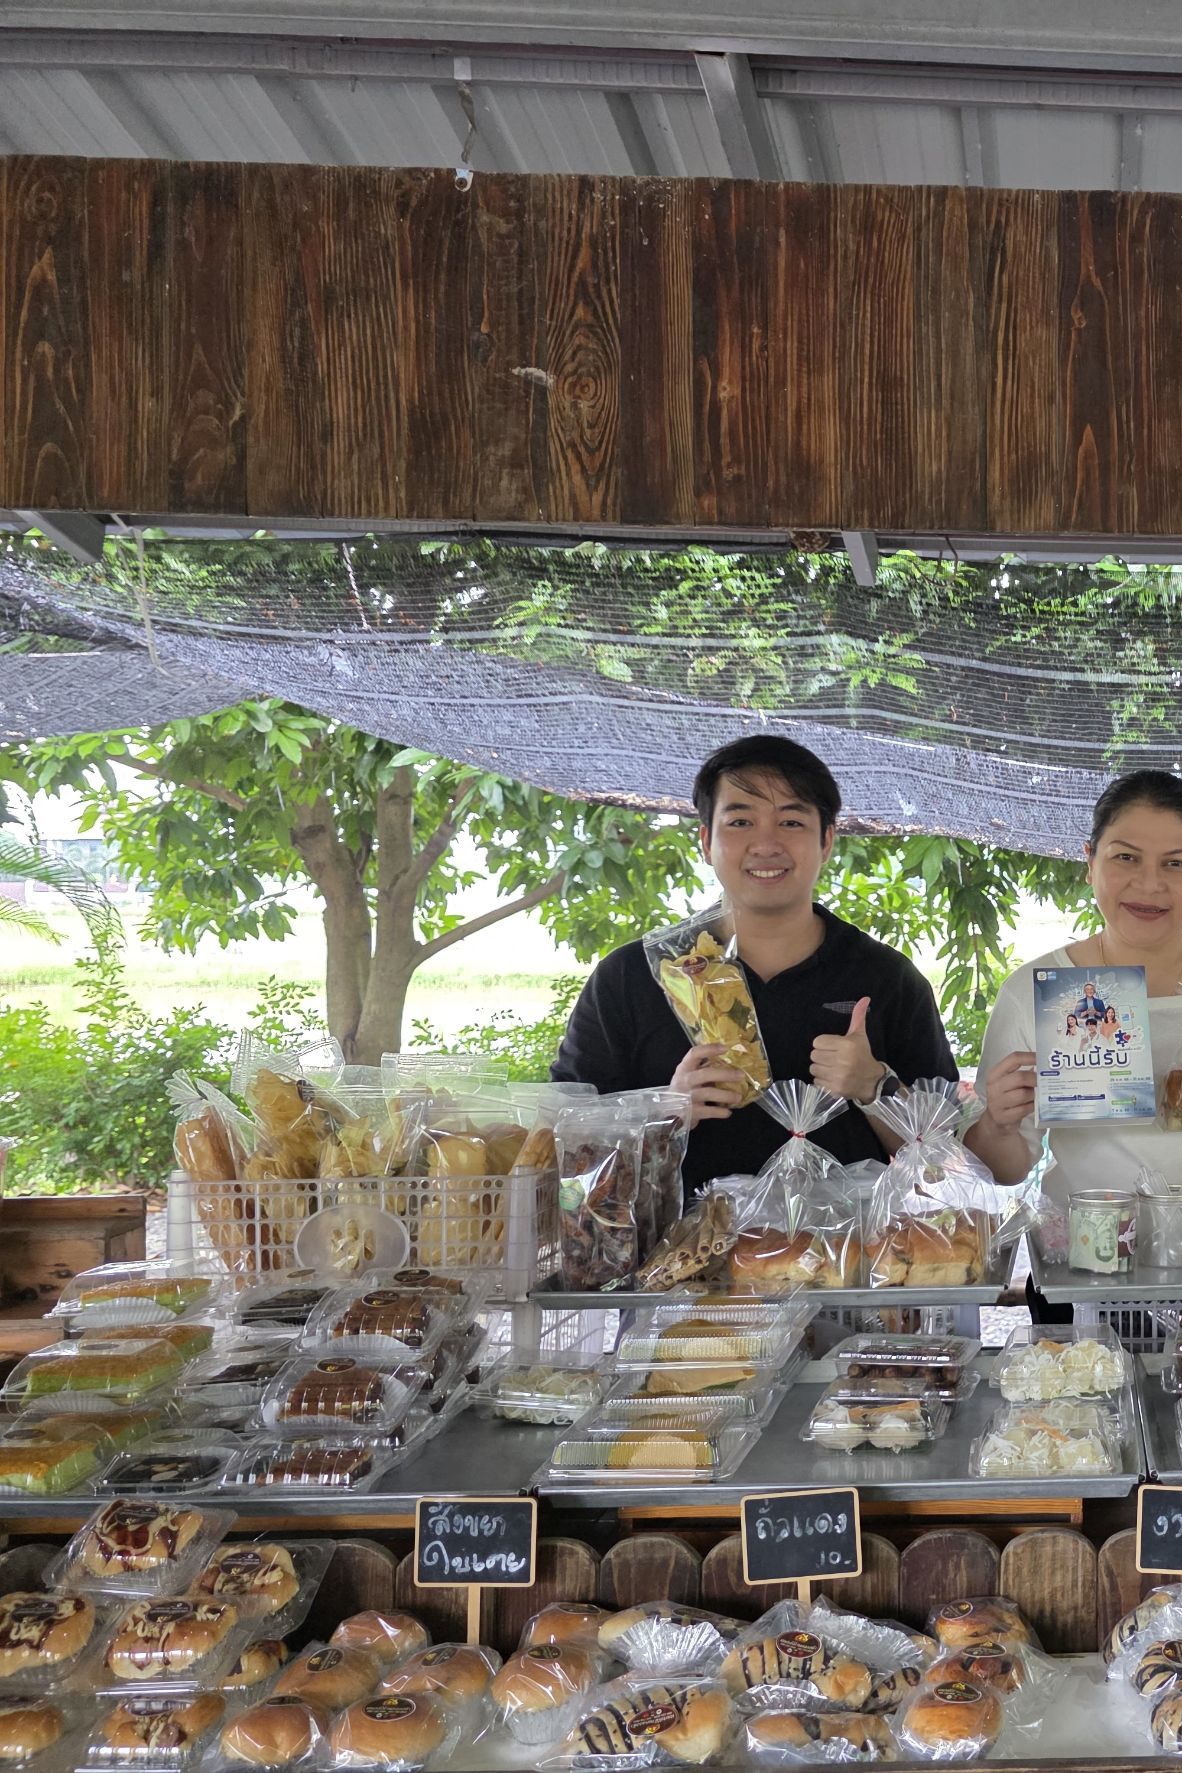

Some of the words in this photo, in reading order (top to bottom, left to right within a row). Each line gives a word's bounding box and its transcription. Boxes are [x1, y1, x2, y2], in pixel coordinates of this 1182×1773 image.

[1050, 1045, 1128, 1068] ร้านนี้รับ
[427, 1502, 507, 1537] สังขยา
[755, 1499, 848, 1542] ถั่วแดง
[423, 1540, 526, 1575] ใบเตย
